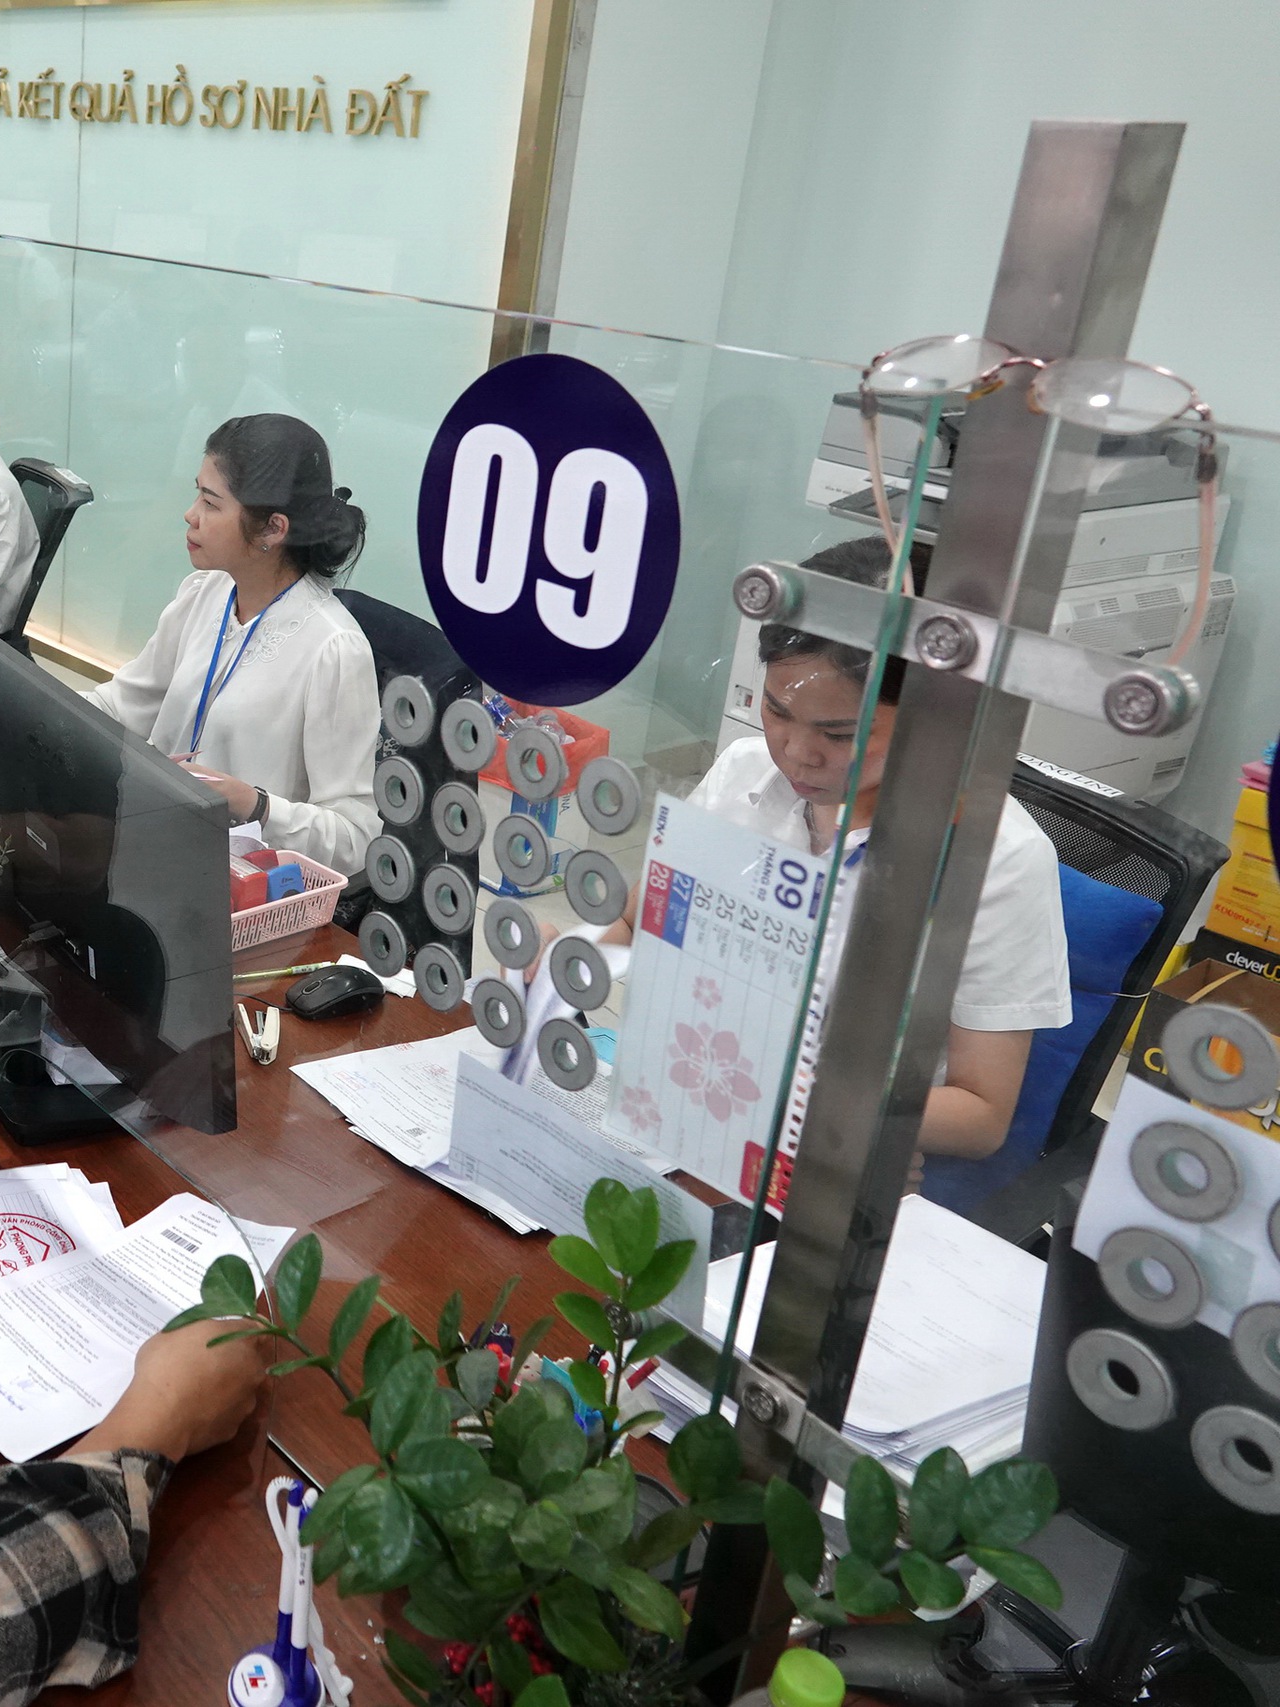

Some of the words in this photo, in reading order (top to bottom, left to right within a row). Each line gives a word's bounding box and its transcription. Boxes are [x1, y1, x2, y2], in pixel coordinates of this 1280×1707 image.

[18, 67, 65, 119] KẾT
[69, 69, 138, 124] QUẢ
[145, 64, 194, 127] HỒ
[199, 79, 247, 129] SƠ
[252, 74, 332, 133] NHÀ
[345, 73, 430, 138] ĐẤT
[442, 423, 648, 650] 09
[649, 863, 670, 891] 28
[674, 871, 695, 903] 27
[775, 860, 809, 911] 09
[695, 883, 715, 912] 26
[716, 894, 737, 923] 25
[739, 905, 760, 934] 24
[764, 916, 785, 945] 23
[787, 927, 810, 957] 22
